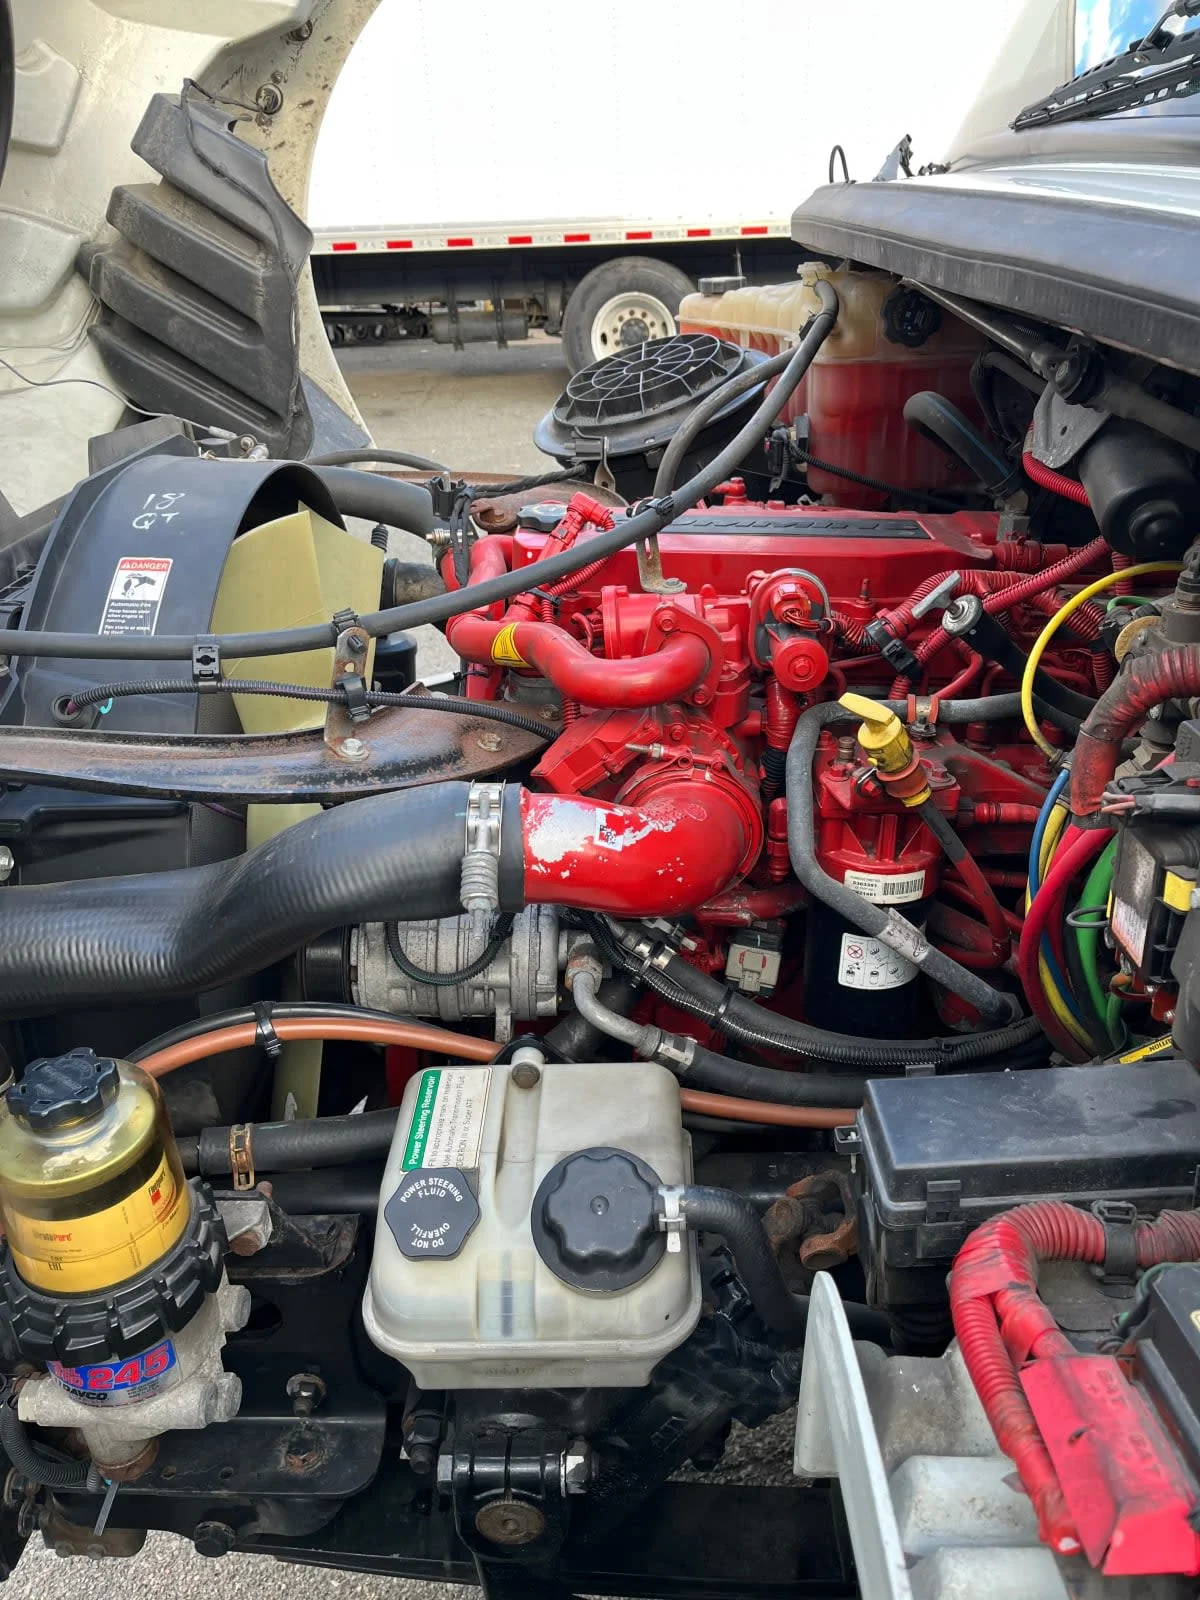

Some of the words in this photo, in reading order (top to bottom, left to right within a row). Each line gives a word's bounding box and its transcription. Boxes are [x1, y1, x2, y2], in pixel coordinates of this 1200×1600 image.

[143, 493, 186, 510] 18
[131, 562, 169, 570] DANGER
[421, 1076, 436, 1109] Reservoir
[450, 1090, 463, 1124] Transmission
[414, 1109, 431, 1140] Steering
[432, 1118, 445, 1149] appropriate
[442, 1095, 449, 1103] on
[444, 1123, 455, 1153] Automatic
[455, 1139, 467, 1167] DEXRON
[462, 1110, 472, 1125] Super
[408, 1141, 422, 1165] Power
[441, 1154, 450, 1167] Use
[400, 1180, 426, 1203] POWER
[428, 1178, 463, 1202] STEERING
[417, 1187, 446, 1198] FLUID
[410, 1222, 450, 1239] OVERFILL
[411, 1238, 429, 1249] NOT
[432, 1238, 445, 1248] DO
[87, 1343, 170, 1390] 245
[62, 1384, 108, 1401] DAVCO
